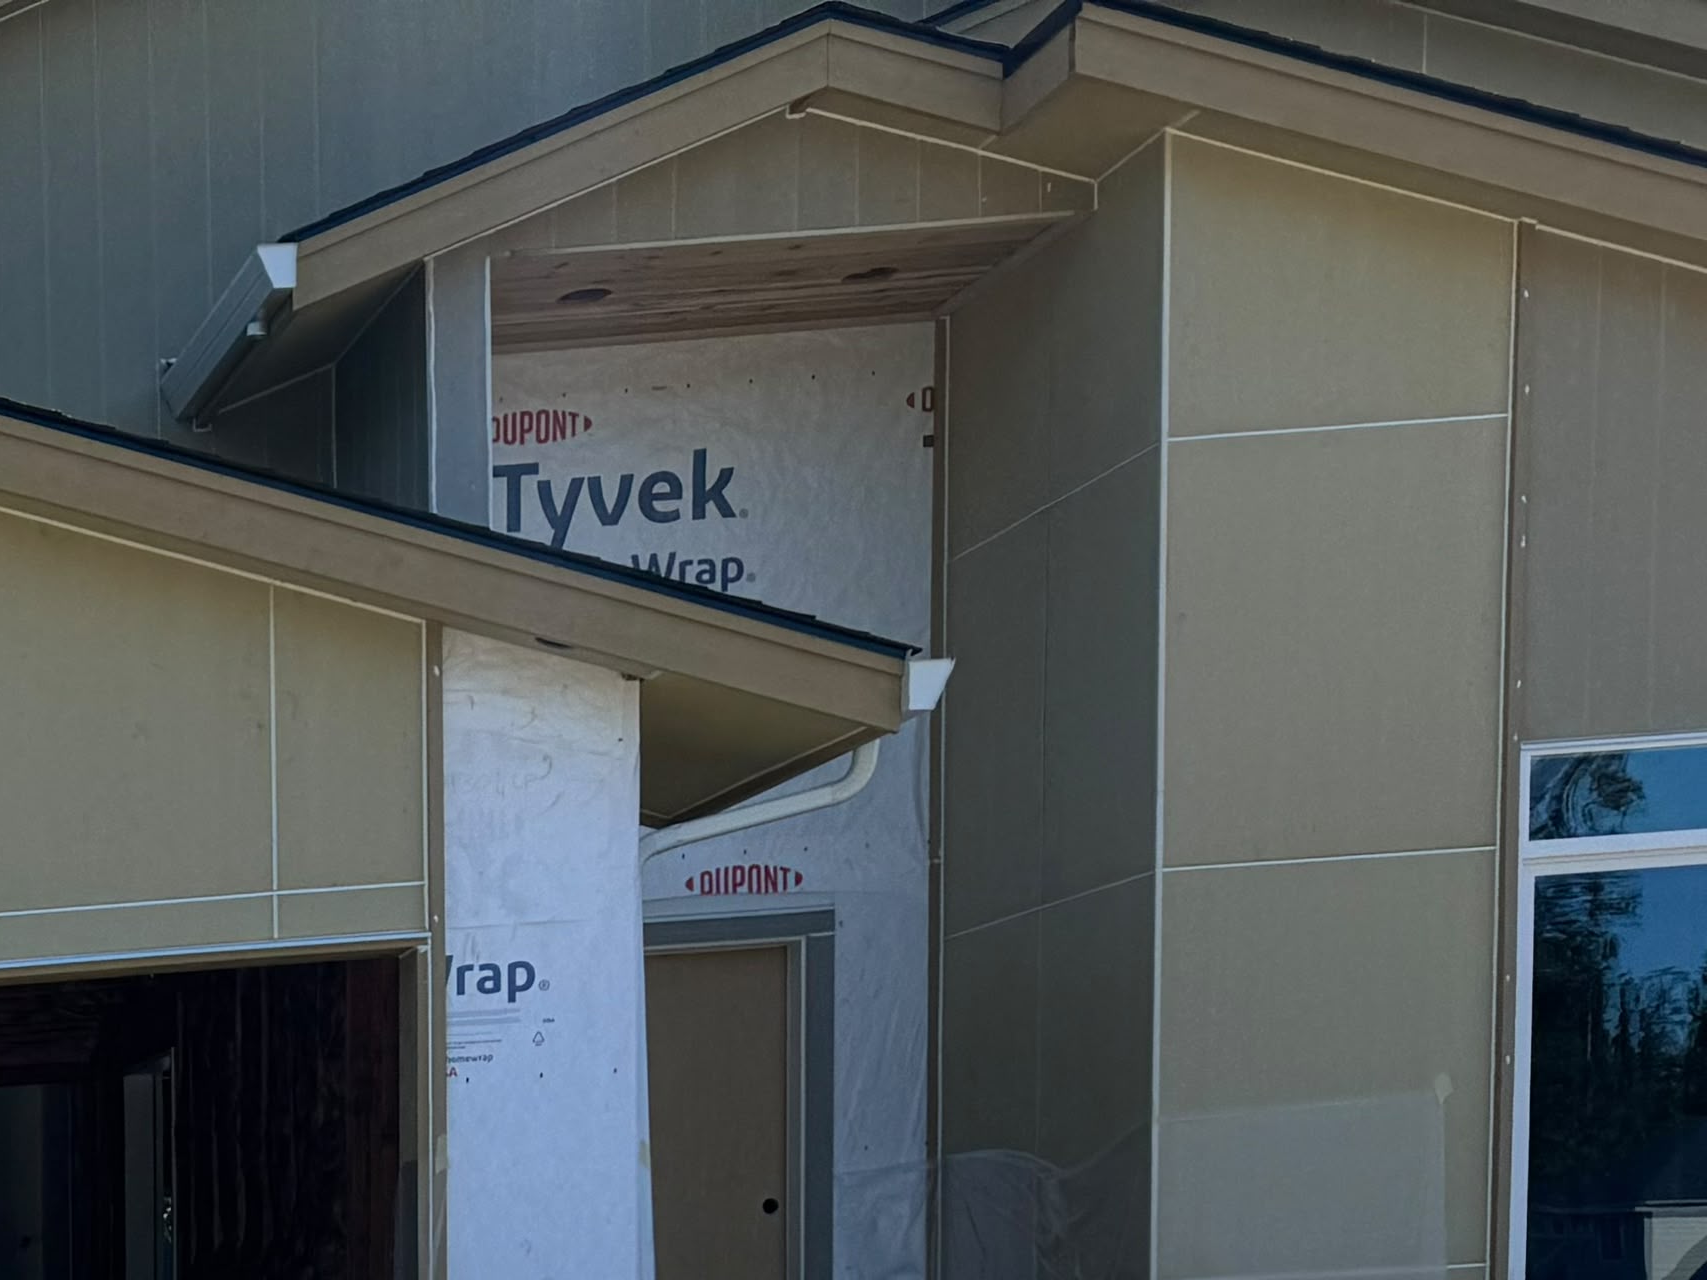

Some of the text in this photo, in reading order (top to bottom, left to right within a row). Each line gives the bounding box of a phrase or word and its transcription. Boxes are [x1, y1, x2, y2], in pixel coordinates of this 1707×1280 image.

[491, 410, 579, 446] DUPONT
[492, 448, 736, 550] Tyvek
[632, 550, 745, 592] Wrap
[700, 864, 791, 896] DUPONT
[445, 954, 536, 1003] rap
